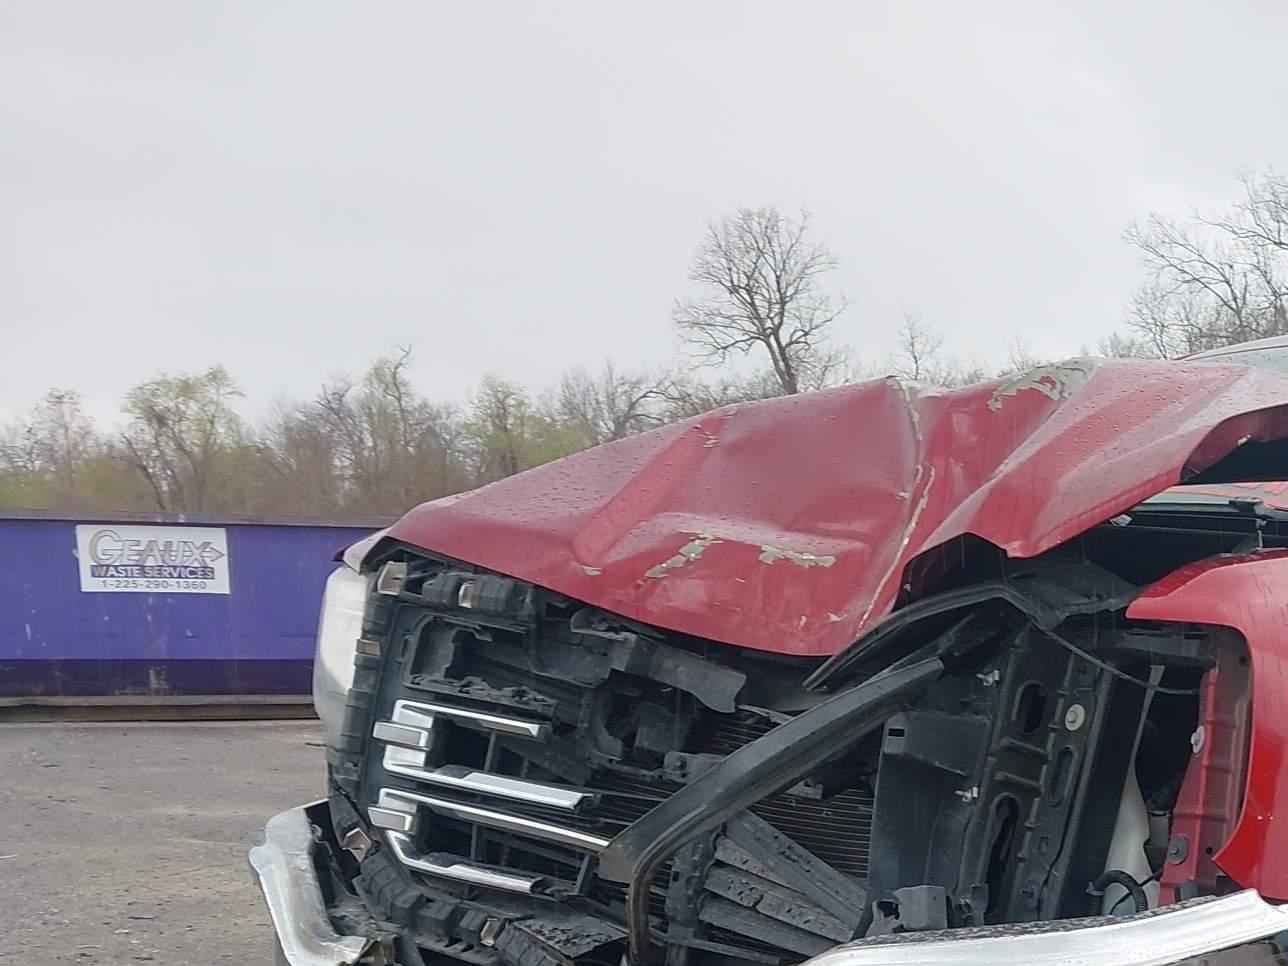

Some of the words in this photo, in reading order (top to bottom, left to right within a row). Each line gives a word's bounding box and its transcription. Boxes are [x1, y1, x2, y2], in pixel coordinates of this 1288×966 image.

[89, 530, 211, 566] GEAUX
[93, 566, 142, 577] WASTE
[144, 566, 213, 578] SERVICES
